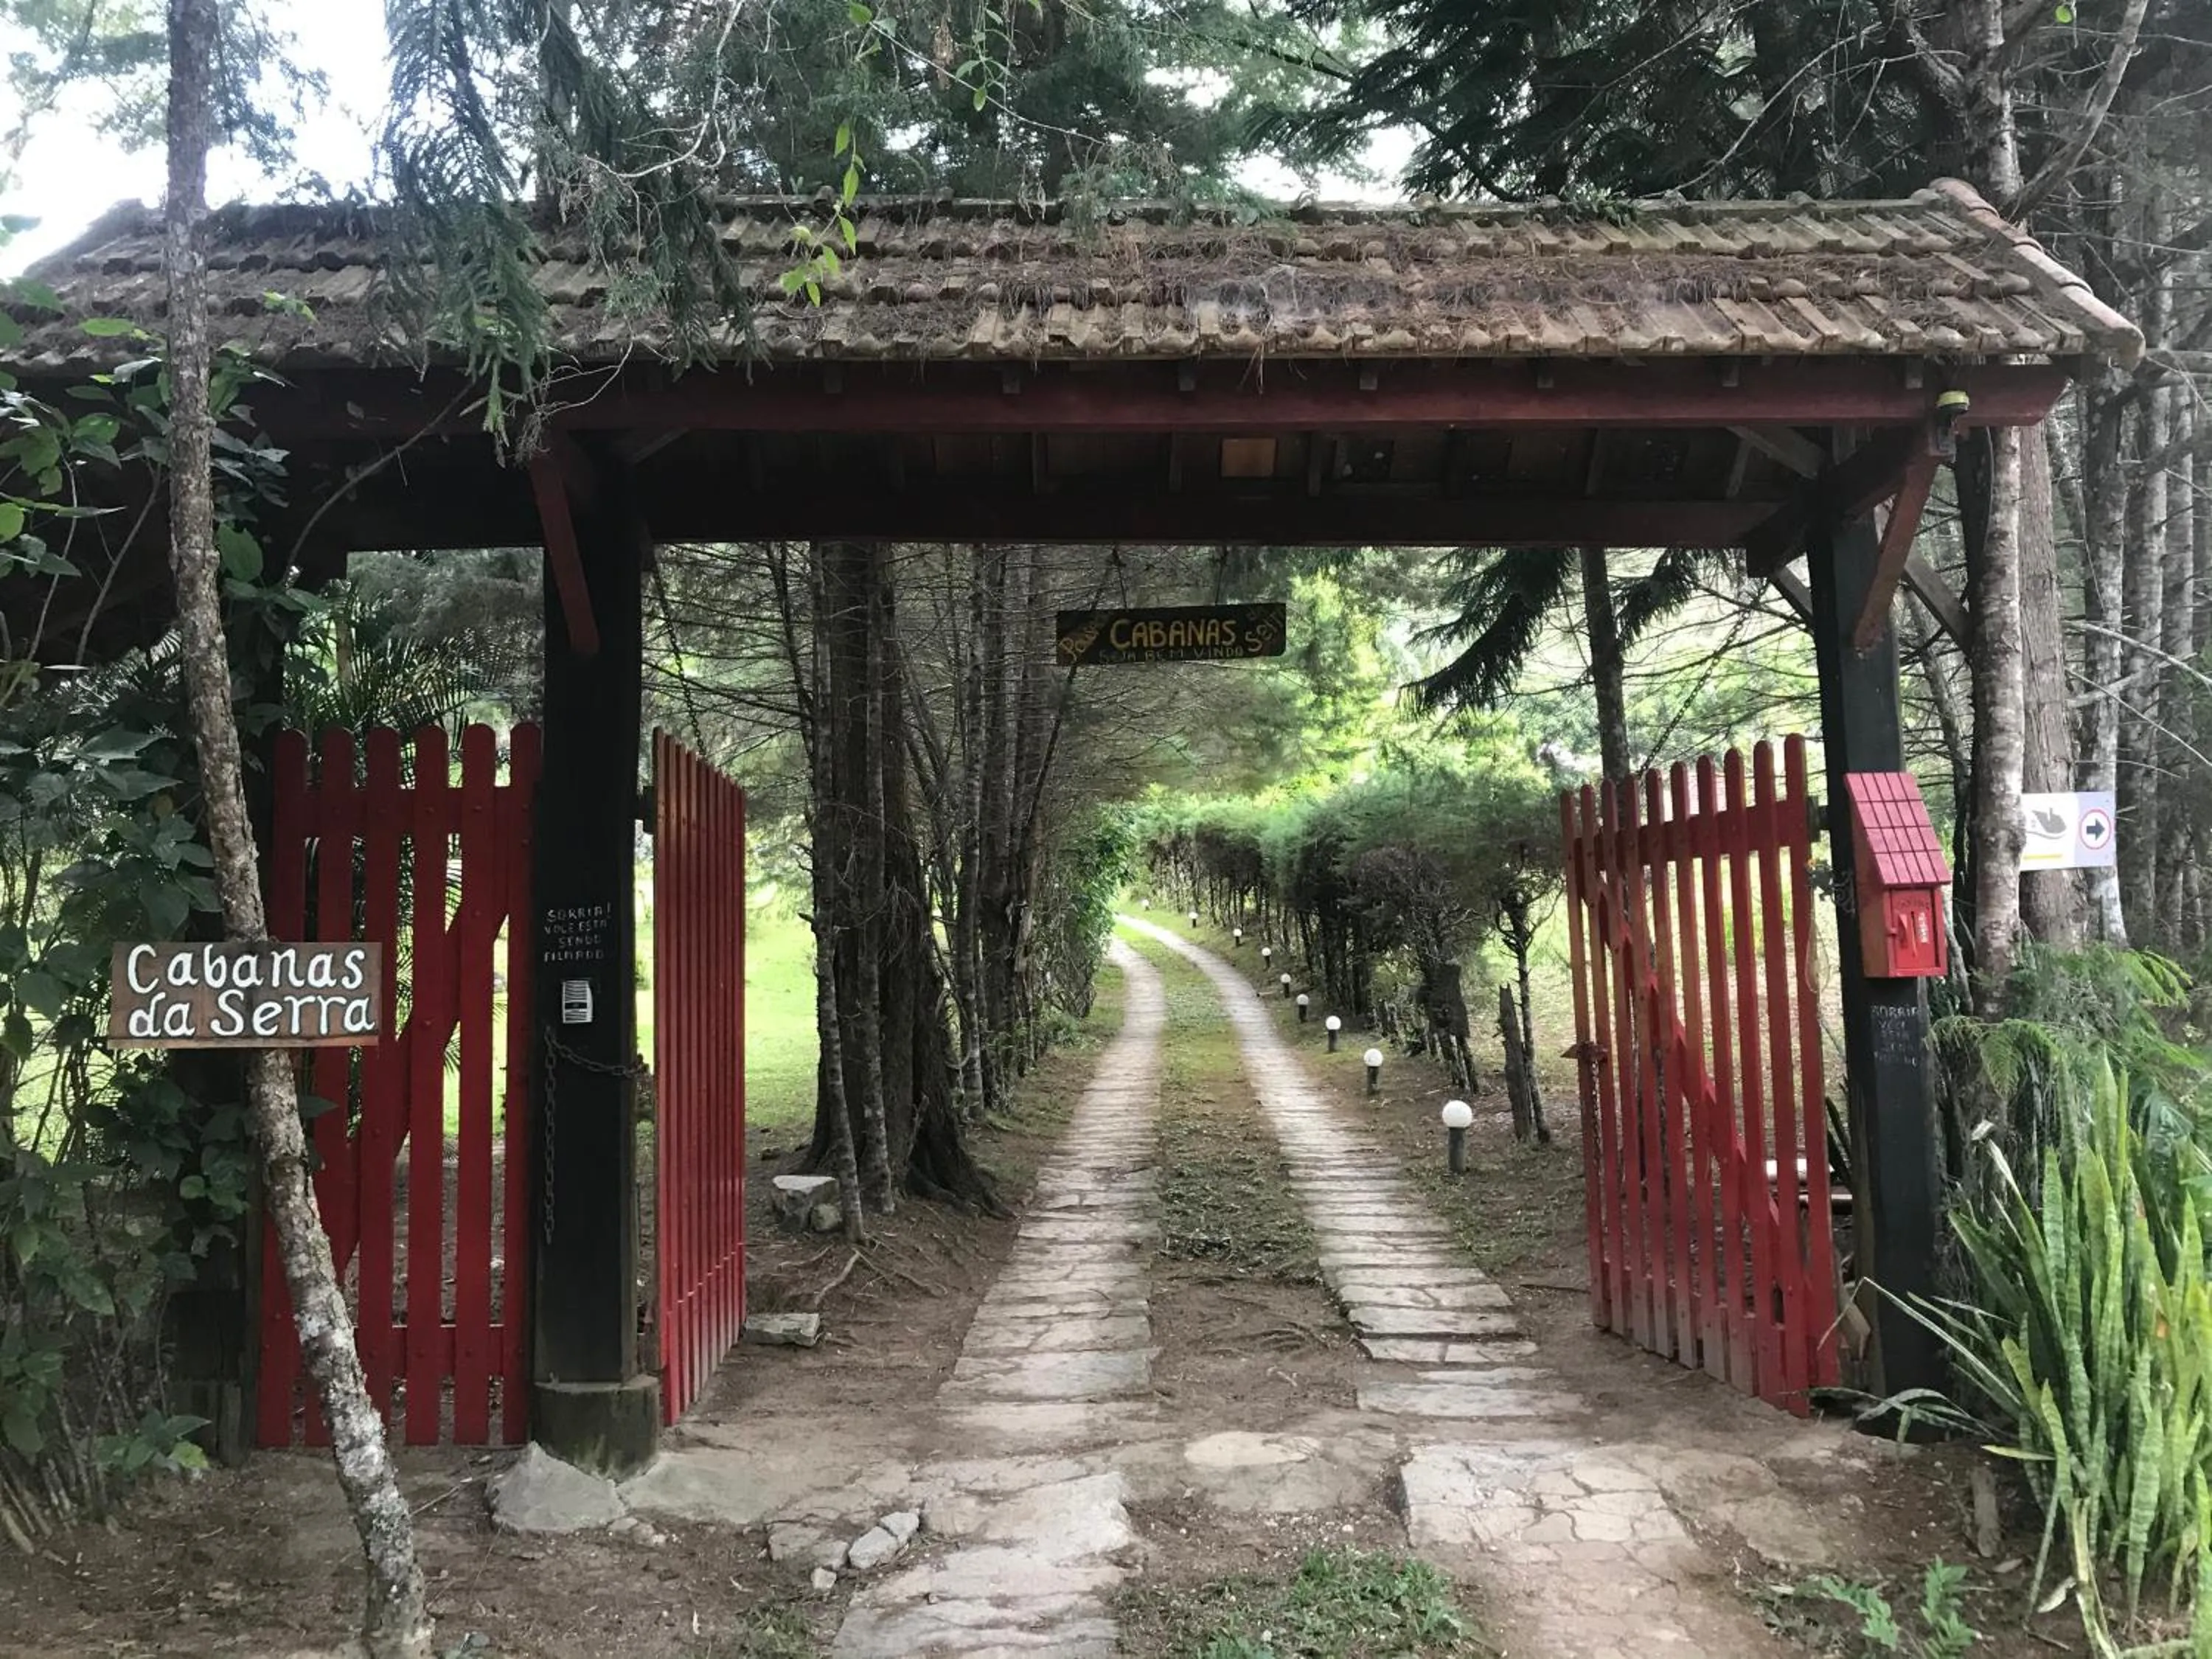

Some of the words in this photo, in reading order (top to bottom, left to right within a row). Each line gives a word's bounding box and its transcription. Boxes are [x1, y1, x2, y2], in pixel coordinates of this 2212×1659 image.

[1110, 619, 1237, 649] CABANAS
[547, 902, 611, 923] SORRIA!
[127, 944, 366, 994] Cabanas
[128, 991, 195, 1038] da
[210, 989, 376, 1036] Serra
